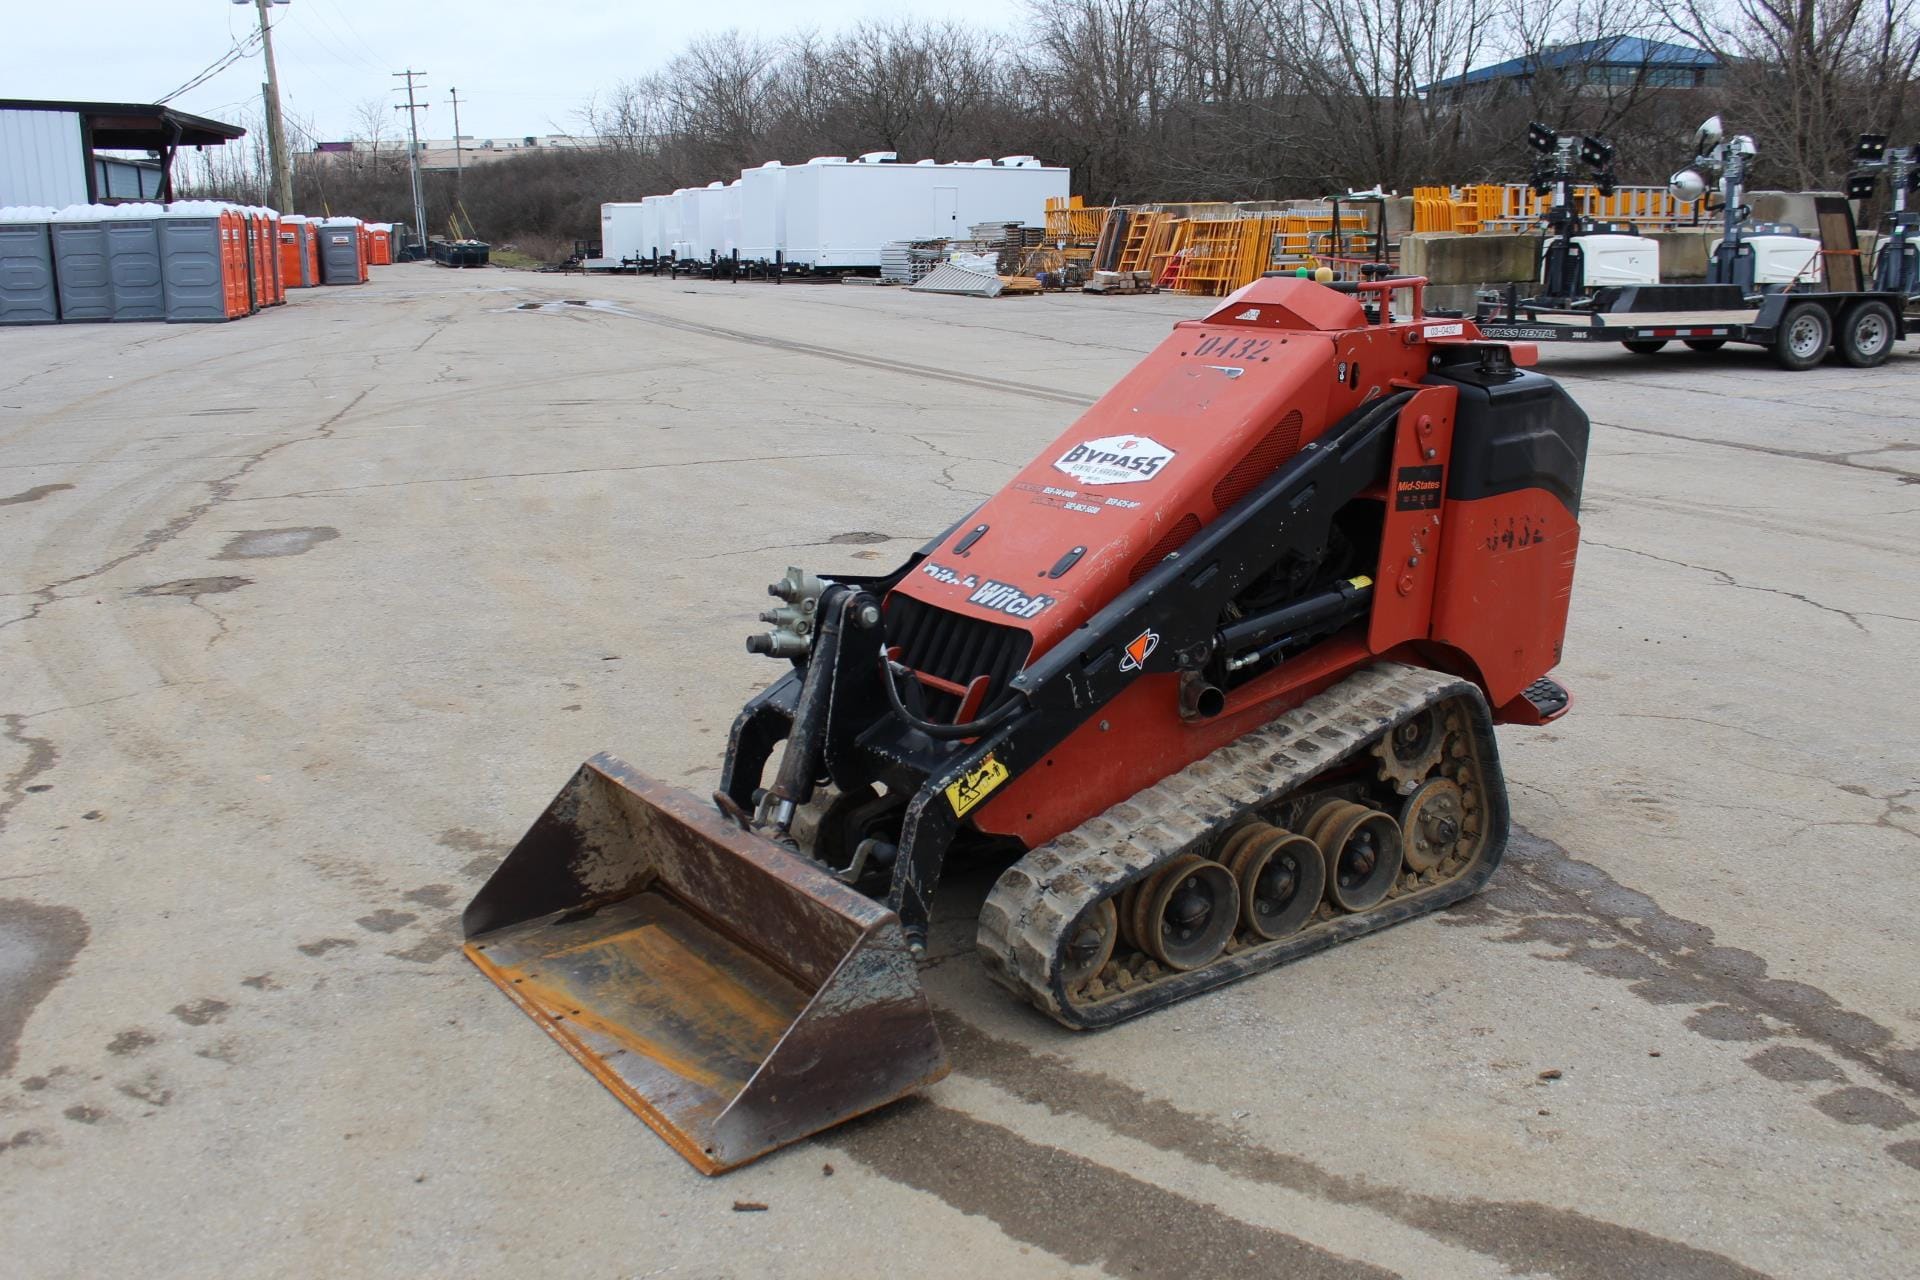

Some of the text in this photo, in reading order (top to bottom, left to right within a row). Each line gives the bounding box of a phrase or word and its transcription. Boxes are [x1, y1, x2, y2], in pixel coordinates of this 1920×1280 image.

[1430, 326, 1456, 336] 03-0432
[1481, 327, 1557, 339] BYPASS RENTAL
[1193, 336, 1273, 360] 0432
[1061, 444, 1166, 476] BYPASS
[1398, 480, 1441, 492] Mid-States
[969, 581, 1045, 618] Witch
